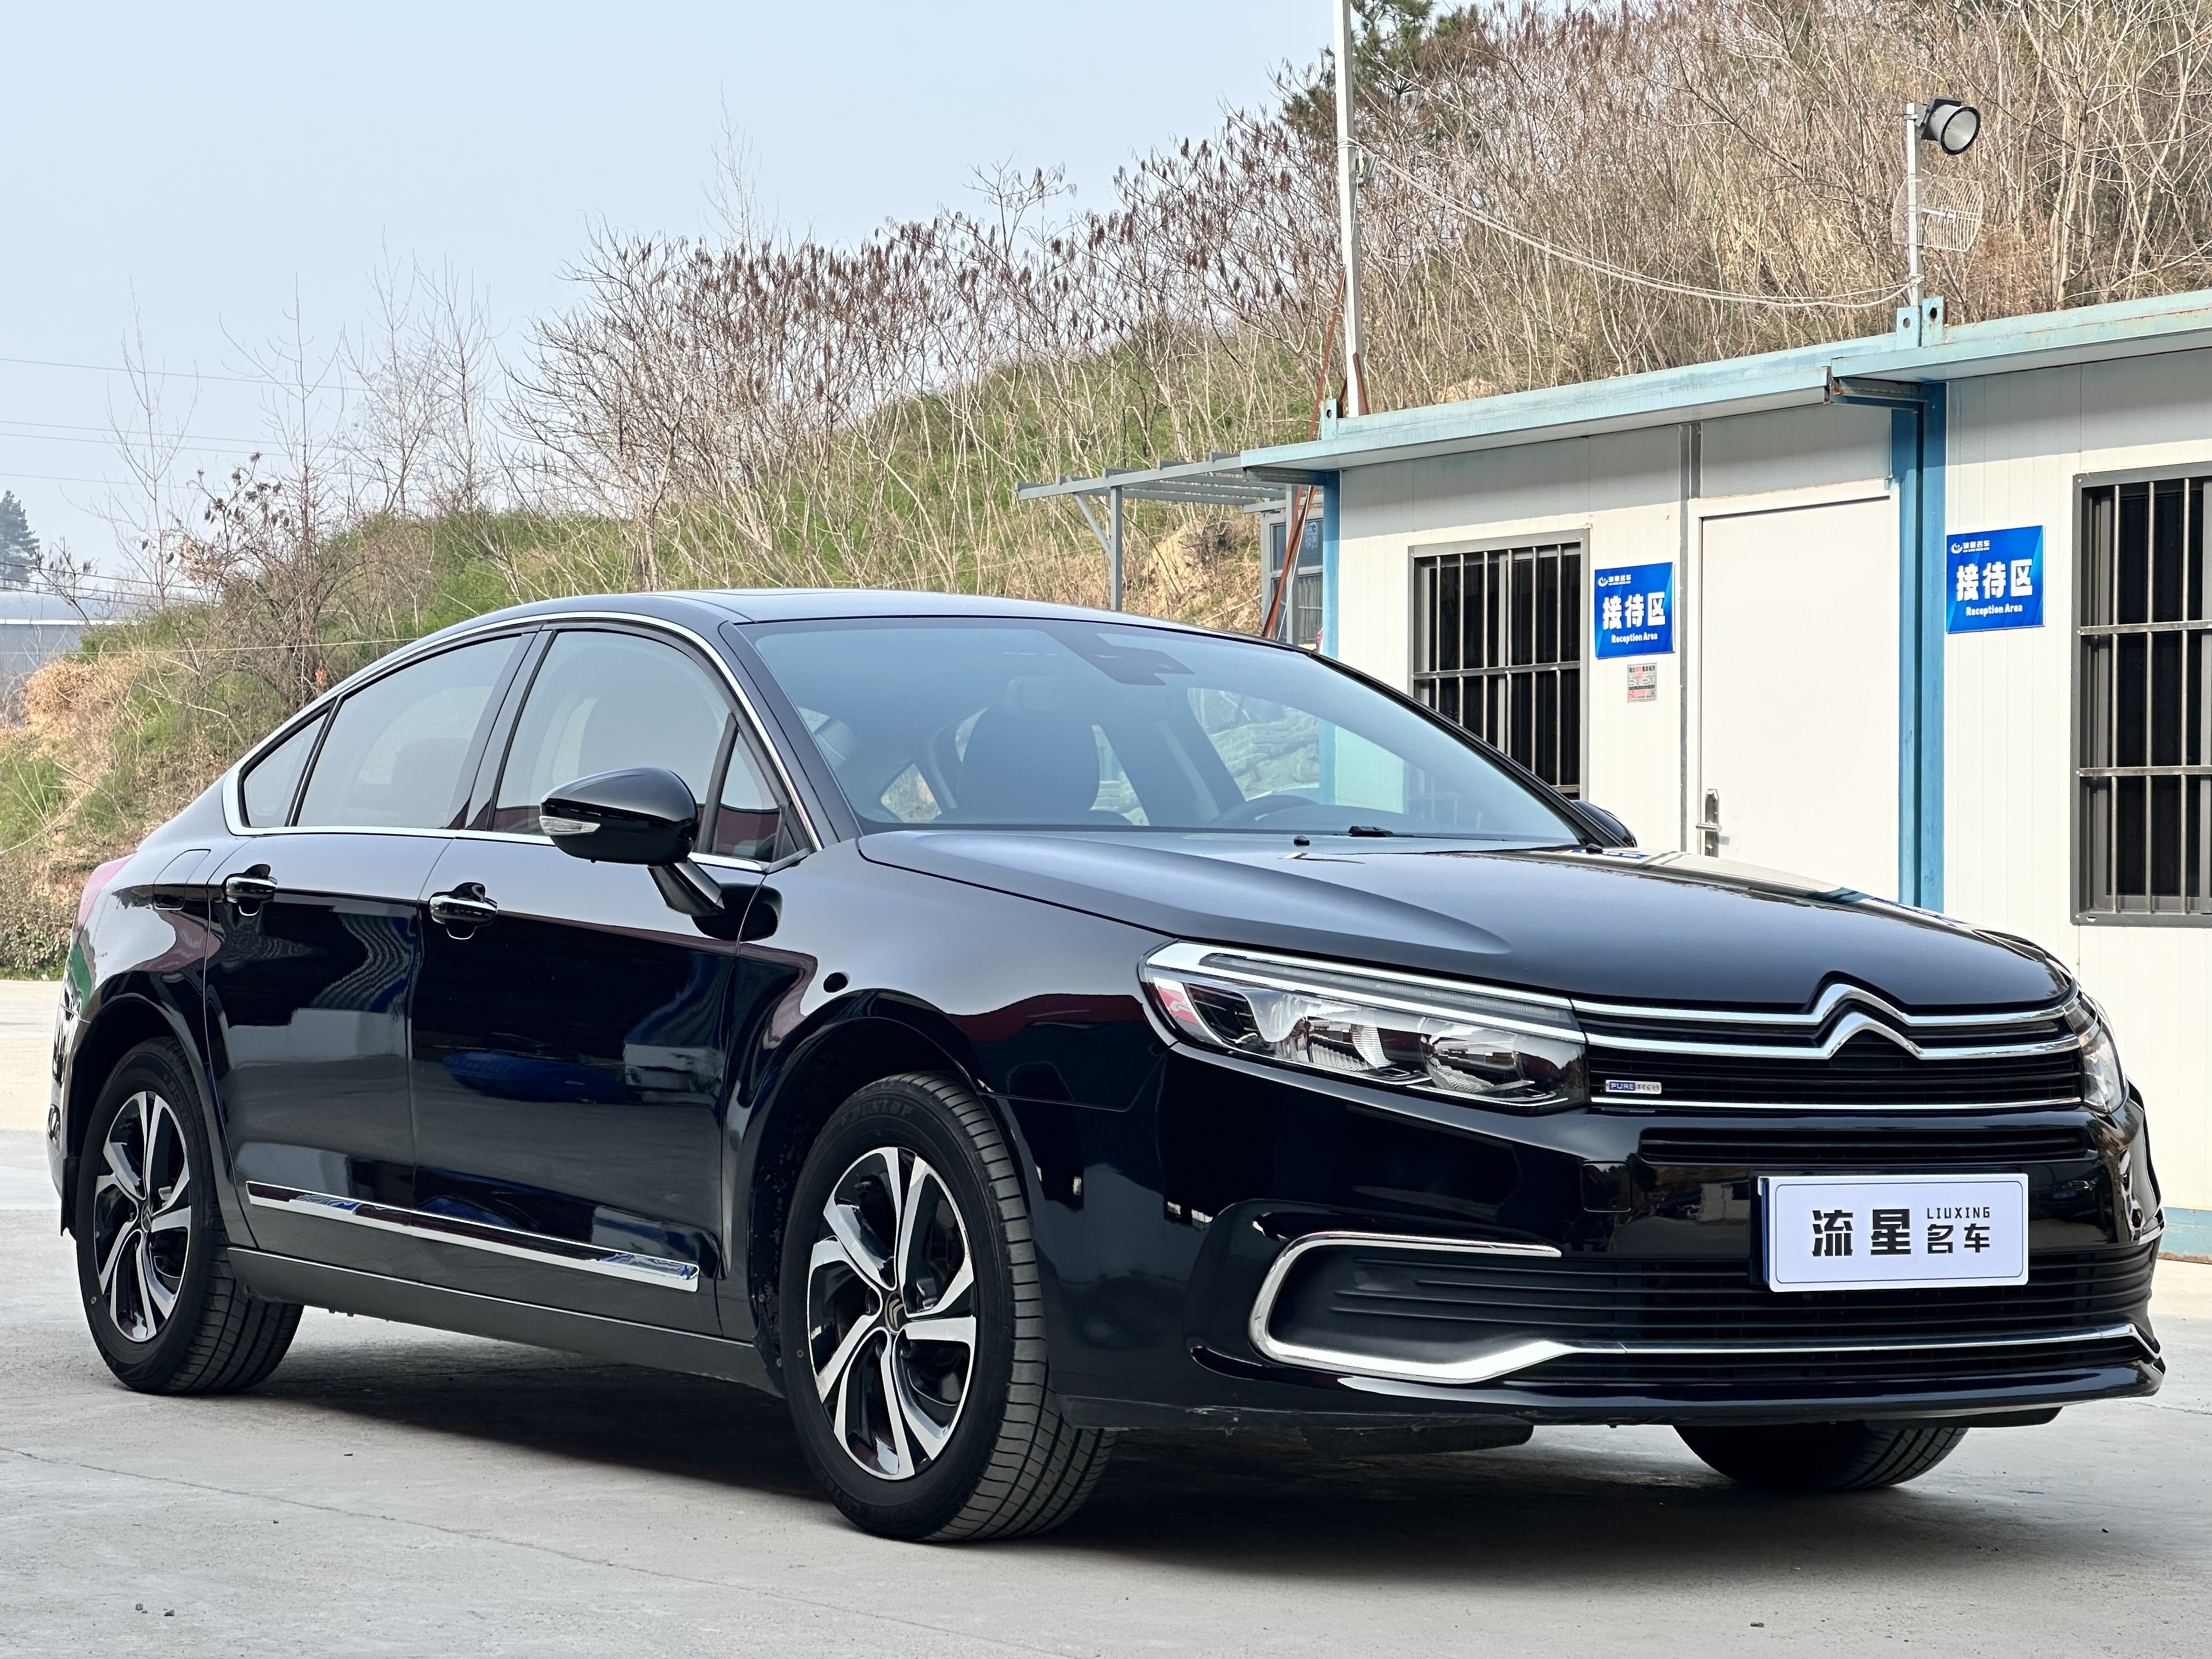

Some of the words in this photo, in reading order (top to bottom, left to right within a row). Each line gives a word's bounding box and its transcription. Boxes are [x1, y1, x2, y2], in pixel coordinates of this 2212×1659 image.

[1957, 558, 2033, 601] 接待区
[1602, 591, 1666, 630] 接待区
[1966, 604, 2004, 617] Reception
[2005, 603, 2023, 613] Area
[1611, 633, 1643, 645] Reception
[1643, 631, 1658, 642] Area
[844, 1099, 913, 1122] DUNLOP
[1927, 1206, 1990, 1219] LIUXING
[1812, 1208, 1911, 1257] 流星
[1927, 1223, 1990, 1254] 名车
